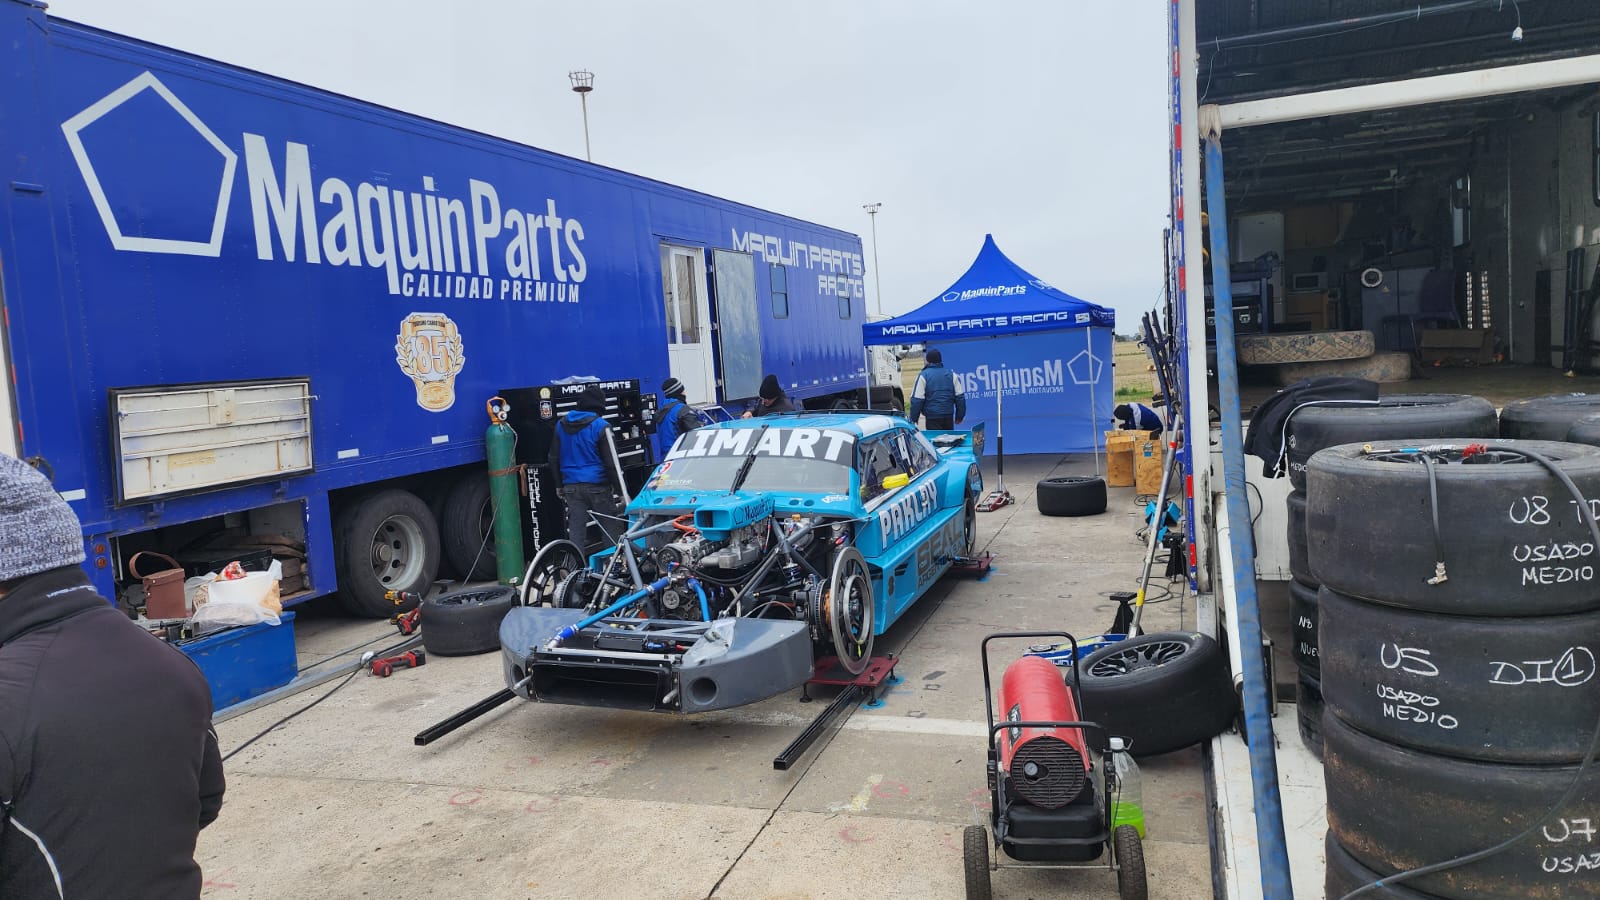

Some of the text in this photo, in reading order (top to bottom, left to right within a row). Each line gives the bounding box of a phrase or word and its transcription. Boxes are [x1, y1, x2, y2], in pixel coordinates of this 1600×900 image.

[243, 132, 587, 295] MaquinParts
[402, 272, 580, 303] CALIDAD PREMIUM
[818, 274, 863, 298] RACING
[882, 321, 944, 336] MAQUIN
[946, 316, 1008, 330] PARTS
[1011, 311, 1068, 324] RACING
[416, 335, 450, 374] 85
[664, 427, 854, 462] LIMART
[917, 517, 963, 576] SEAL
[1513, 543, 1594, 562] USADO
[1522, 565, 1594, 586] MEDIO
[1376, 683, 1440, 707] USADO
[1383, 703, 1458, 729] MEDIO
[1542, 817, 1597, 842] U7
